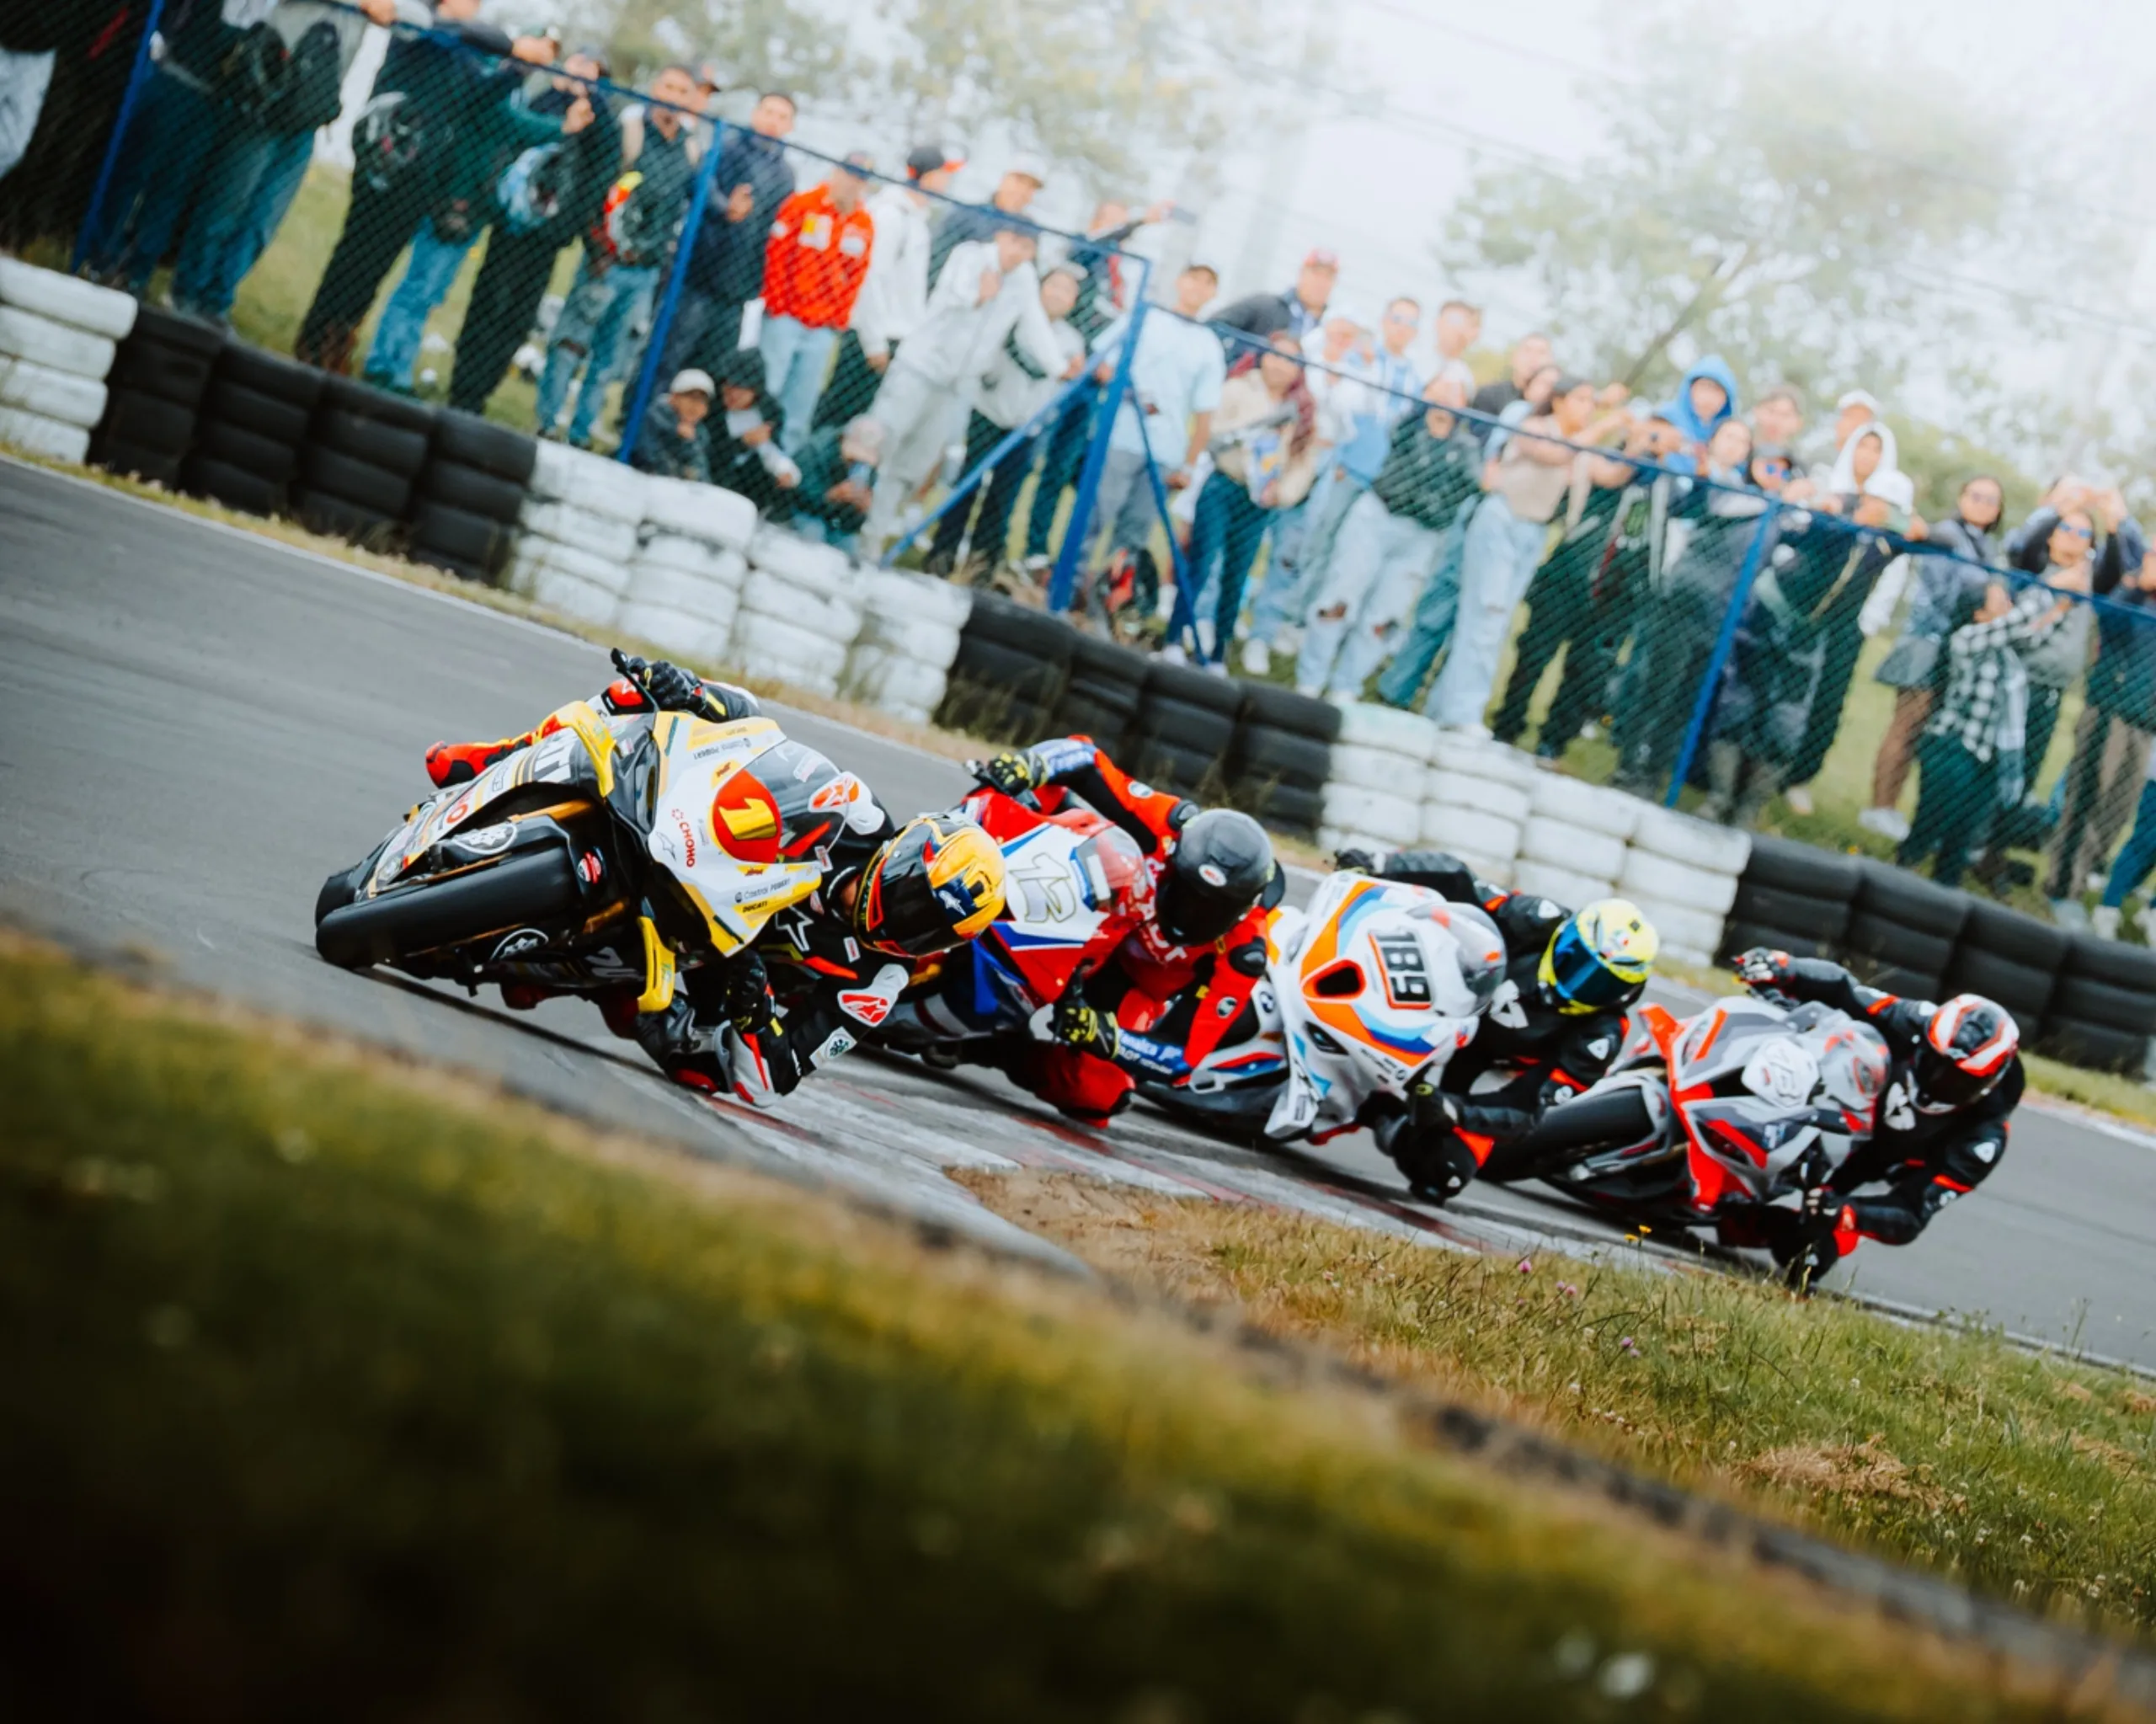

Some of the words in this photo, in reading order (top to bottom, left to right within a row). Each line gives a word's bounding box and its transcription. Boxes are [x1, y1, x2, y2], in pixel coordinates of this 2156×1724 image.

[718, 798, 777, 840] 1
[680, 821, 696, 867] CHOHO
[742, 901, 768, 913] DUCATI
[1375, 931, 1432, 1003] 189
